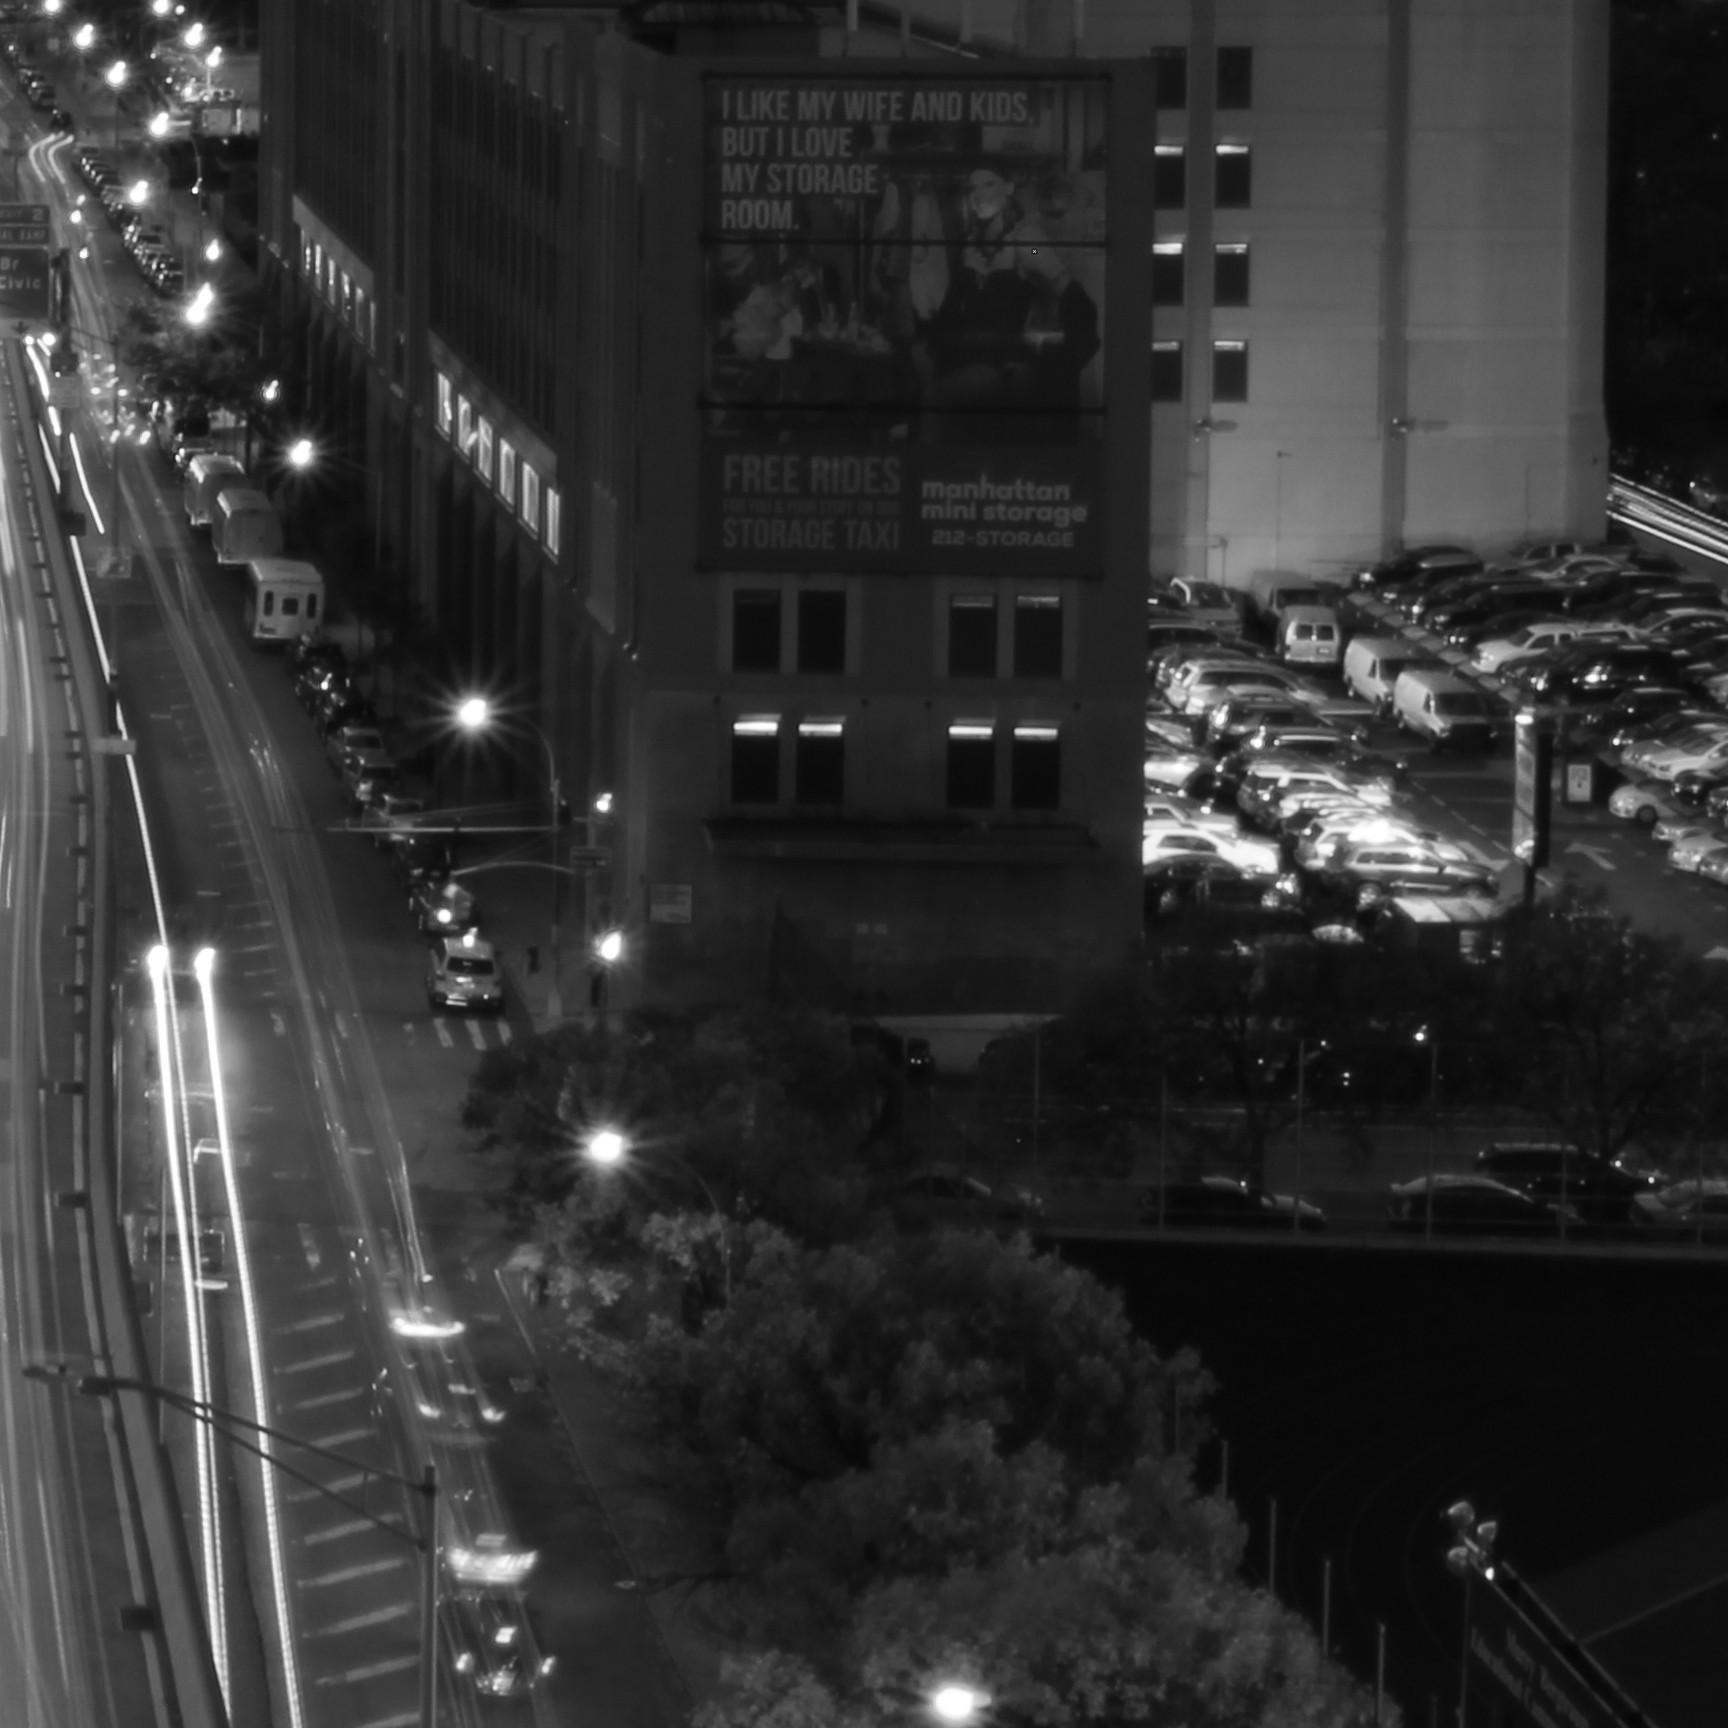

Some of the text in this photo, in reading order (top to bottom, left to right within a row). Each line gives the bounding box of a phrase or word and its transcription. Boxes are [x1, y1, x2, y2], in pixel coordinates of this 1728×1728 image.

[722, 90, 1034, 125] I LIKE MY WIFE AND KIDS,
[721, 126, 853, 158] BUT I LOVE
[721, 163, 879, 194] MY STORAGE
[32, 208, 44, 221] 2
[721, 199, 800, 230] ROOM.
[0, 257, 19, 271] Br
[723, 455, 902, 495] FREE RIDES
[921, 473, 1070, 501] manhattan
[921, 500, 1088, 528] mini storage
[722, 518, 900, 551] STORAGE TAXI
[932, 529, 1075, 548] 212-STORAGE
